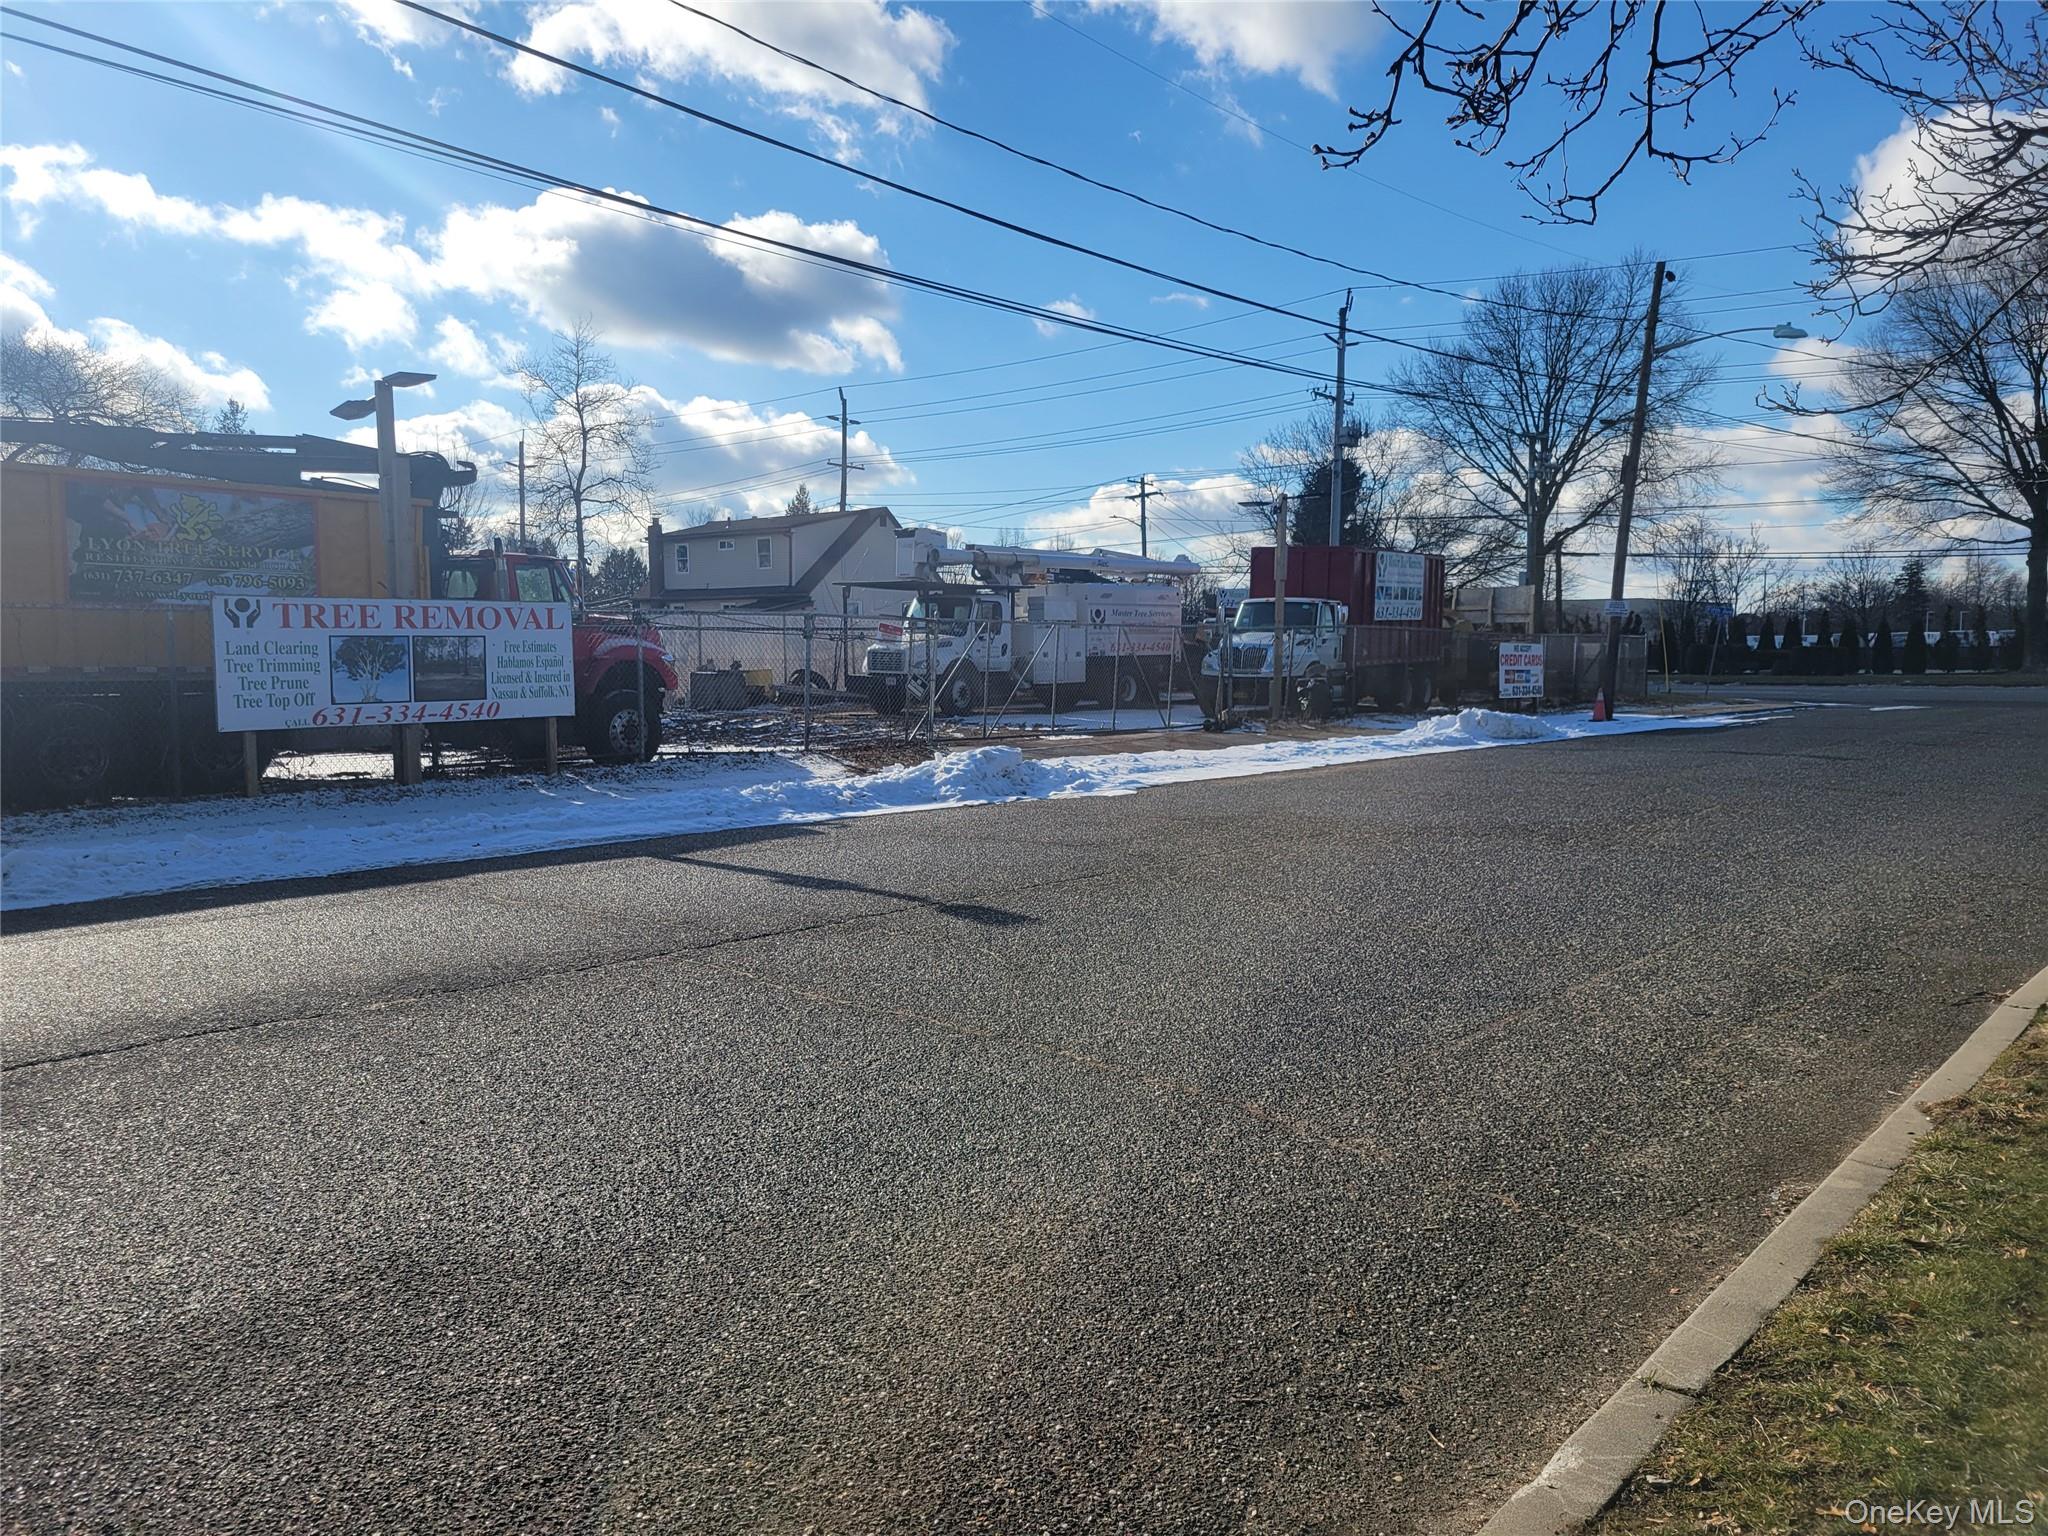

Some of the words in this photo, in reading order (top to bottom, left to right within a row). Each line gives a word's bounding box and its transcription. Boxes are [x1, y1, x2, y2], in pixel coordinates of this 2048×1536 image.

[87, 536, 146, 551] LYON
[158, 541, 207, 556] TREE
[216, 544, 299, 561] SERVICE
[83, 571, 111, 580] (631)
[113, 569, 193, 585] 737-6347
[234, 573, 306, 591] 796-5093
[272, 602, 382, 630] TREE
[392, 605, 565, 631] REMOVAL
[225, 640, 260, 656] Land
[264, 640, 320, 658] Clearing
[503, 640, 521, 653] Free
[522, 640, 558, 653] Estimates
[224, 658, 254, 673] Tree
[259, 657, 321, 675] Trimming
[497, 656, 535, 670] Hablamos
[535, 654, 565, 669] Español
[1501, 654, 1523, 666] CREDIT
[1524, 654, 1543, 666] CARDS
[237, 676, 268, 691] Tree
[271, 676, 310, 690] Prune
[491, 671, 524, 685] Licensed
[525, 671, 533, 684] &
[534, 670, 562, 684] Insured
[563, 670, 572, 683] in
[233, 693, 263, 709] Tree
[265, 693, 292, 711] Top
[294, 692, 317, 707] Off
[491, 686, 519, 700] Nassau
[521, 686, 529, 699] &
[285, 718, 310, 728] CALL
[312, 700, 501, 727] 631-334-4540
